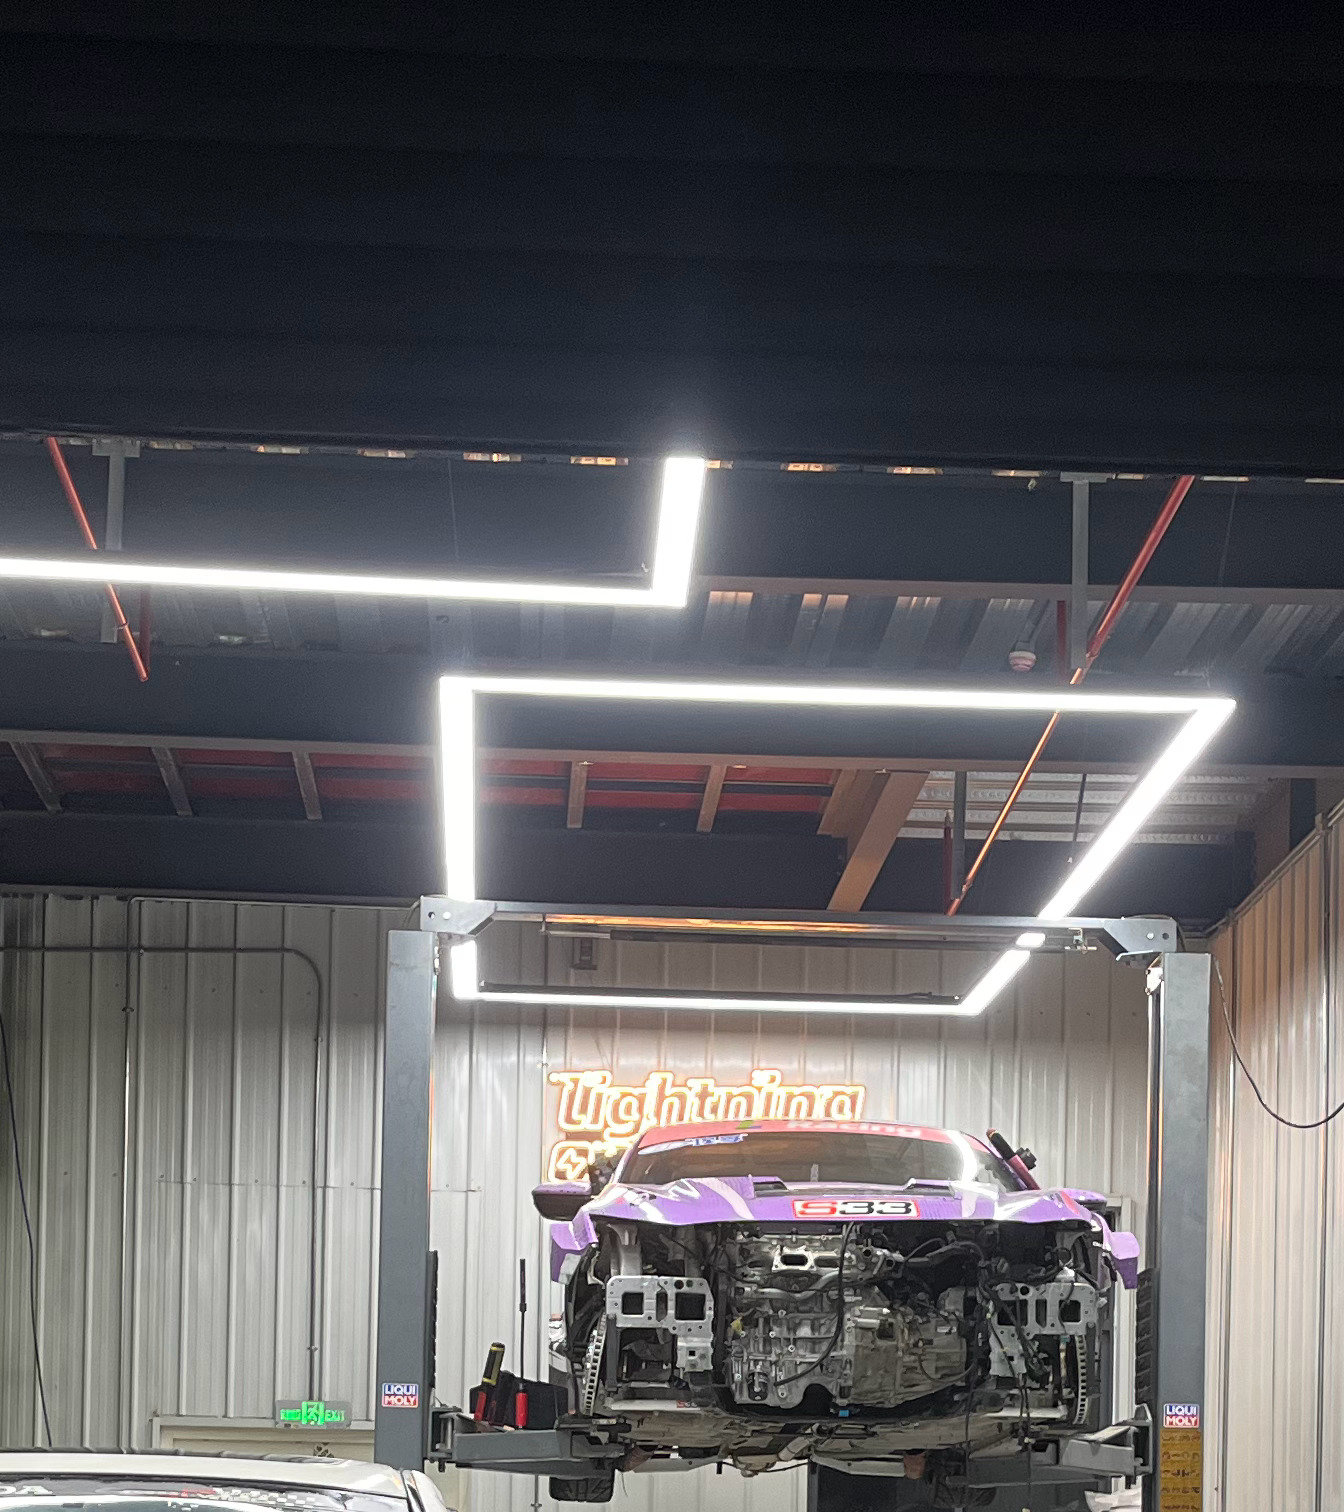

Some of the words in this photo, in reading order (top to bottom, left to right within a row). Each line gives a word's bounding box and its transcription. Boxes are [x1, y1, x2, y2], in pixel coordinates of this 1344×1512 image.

[798, 1200, 913, 1216] S33
[385, 1384, 416, 1395] LIQUI
[384, 1395, 417, 1406] MOLY
[1166, 1405, 1197, 1416] LIQUI
[1166, 1415, 1197, 1426] MOLY
